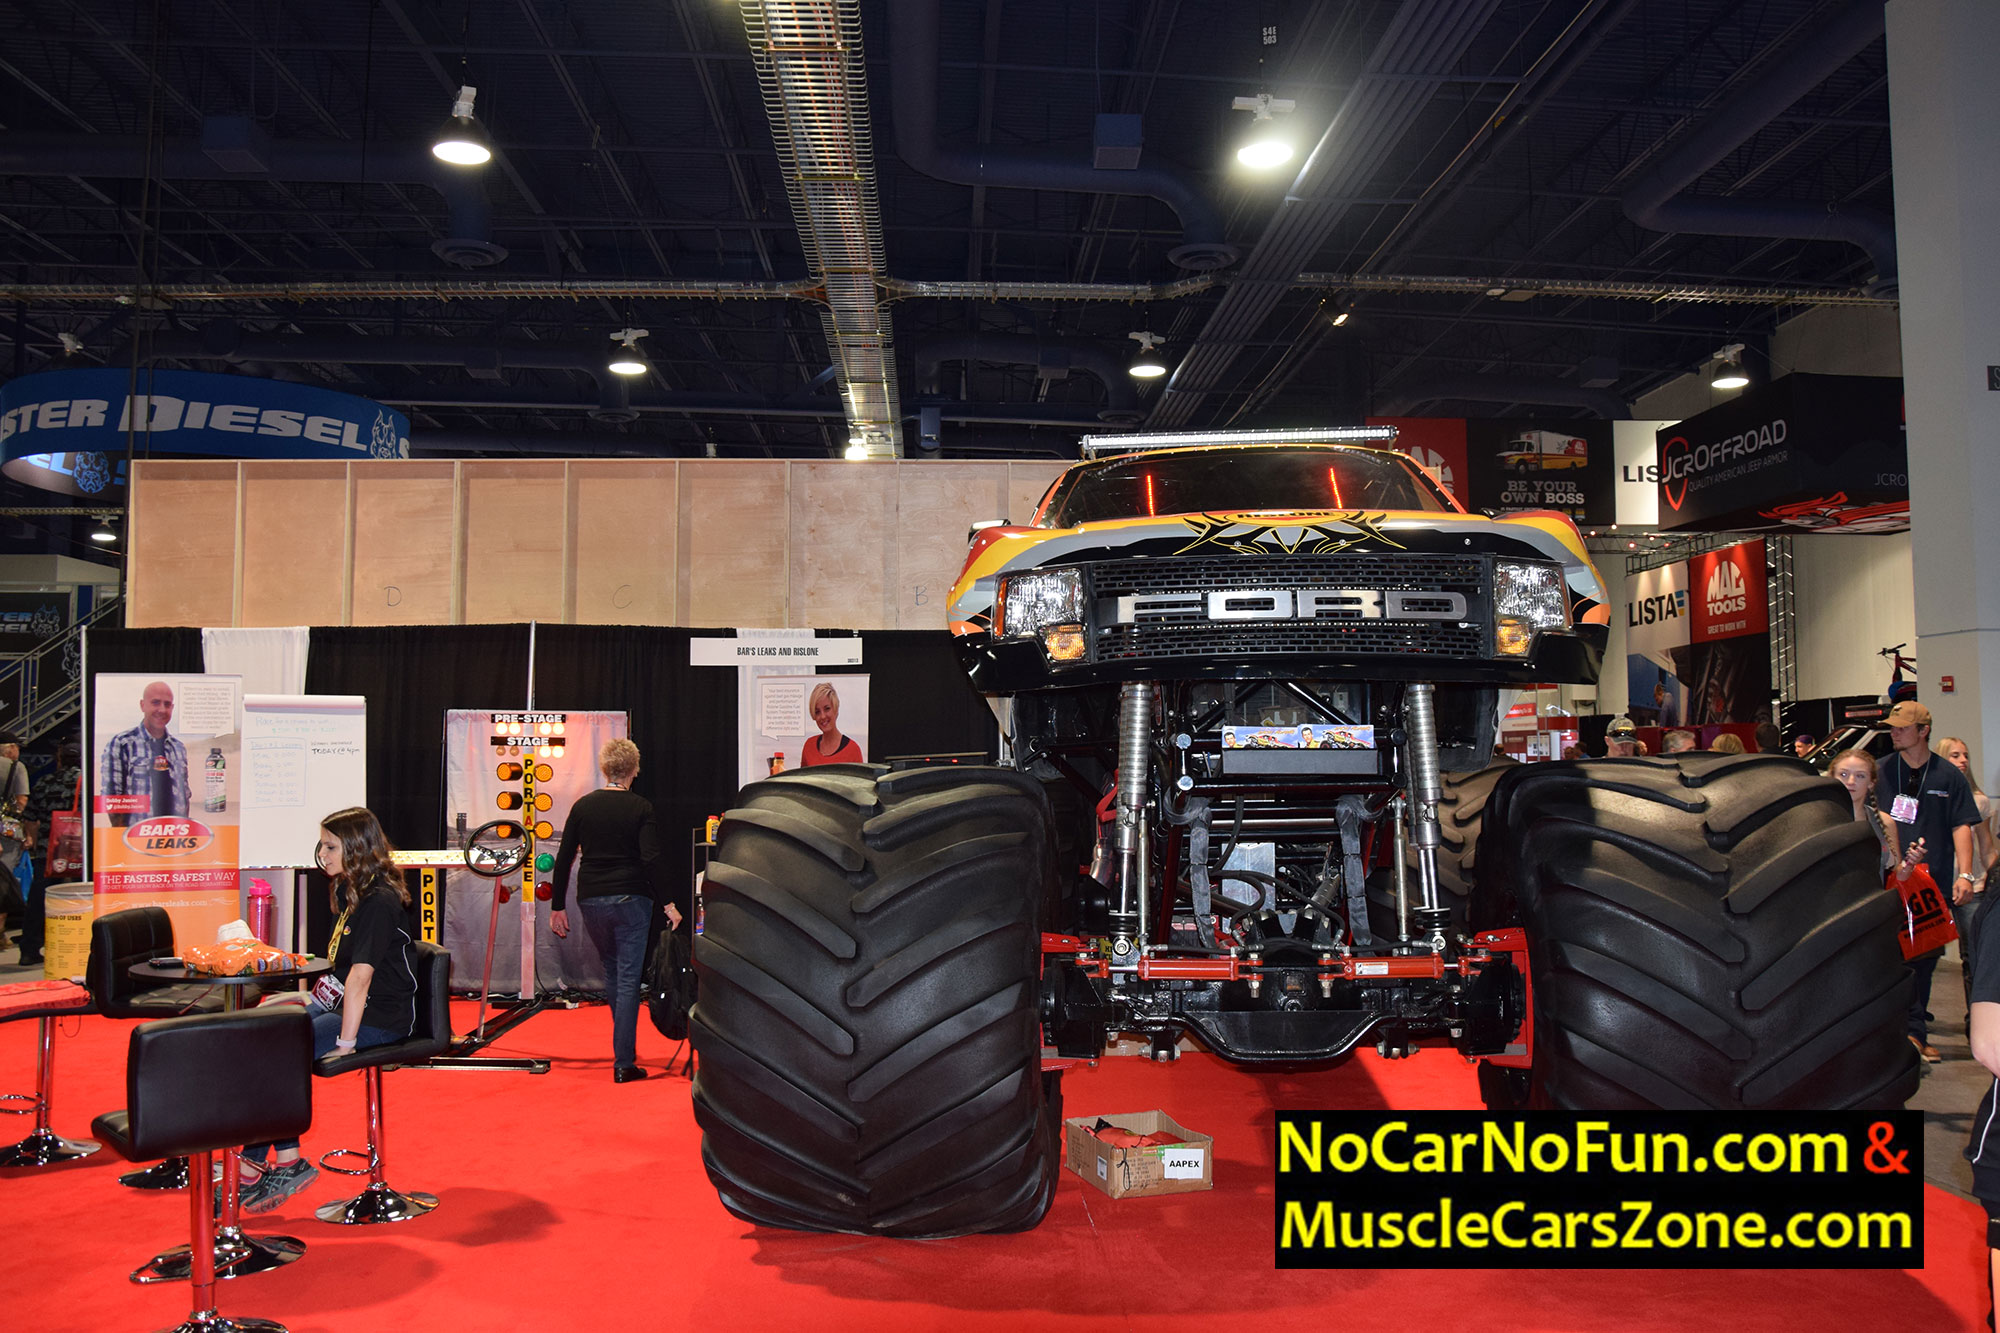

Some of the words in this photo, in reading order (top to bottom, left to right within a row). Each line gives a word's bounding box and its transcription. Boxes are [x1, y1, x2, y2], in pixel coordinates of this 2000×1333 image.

[1262, 26, 1277, 36] S4E
[1263, 35, 1277, 45] 503
[118, 394, 368, 452] DIESEL
[1688, 475, 1713, 492] QUALITY
[1714, 466, 1747, 486] AMERICAN
[1746, 460, 1763, 474] JEEP
[1762, 450, 1789, 467] ARMOR
[1507, 480, 1528, 492] BE
[1533, 481, 1578, 493] YOUR
[1500, 491, 1540, 504] OWN
[1544, 492, 1585, 505] BOSS
[1706, 560, 1747, 603] MAC
[384, 586, 403, 607] D
[612, 585, 633, 610] C
[914, 585, 929, 606] B
[1117, 589, 1468, 623] FORD
[1629, 593, 1678, 628] LISTA
[1706, 596, 1747, 617] TOOLS
[736, 647, 757, 657] BAR'S
[757, 647, 777, 657] LEAKS
[778, 647, 792, 657] AND
[793, 647, 819, 657] RISLONE
[494, 714, 563, 724] PRE-STAGE
[507, 737, 550, 746] STAGE
[523, 758, 534, 883] PORTAEE
[139, 823, 191, 837] BAR'S
[146, 837, 198, 850] LEAKS
[100, 874, 124, 885] THE
[123, 873, 170, 884] FASTEST,
[172, 872, 212, 882] SAFEST
[213, 871, 236, 881] WAY
[422, 874, 435, 940] PORT
[1168, 1160, 1200, 1168] AAPEX
